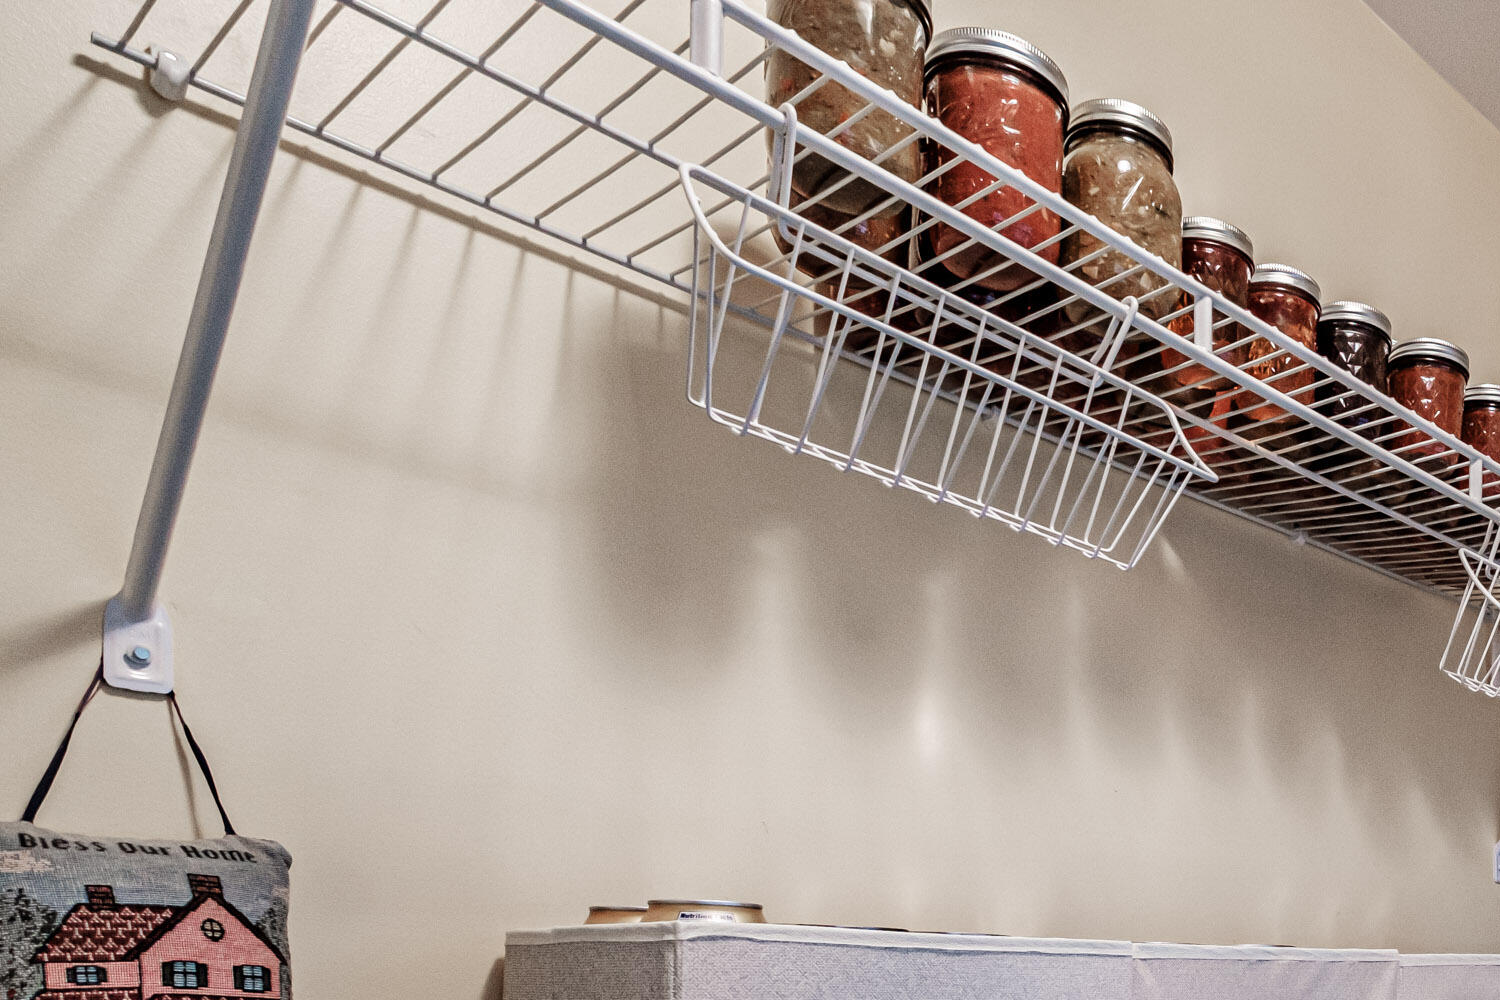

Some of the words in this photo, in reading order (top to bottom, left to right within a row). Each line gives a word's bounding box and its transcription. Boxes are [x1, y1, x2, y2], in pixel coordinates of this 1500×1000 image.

[18, 832, 107, 852] Bless
[117, 842, 171, 856] Our
[180, 845, 257, 864] Home
